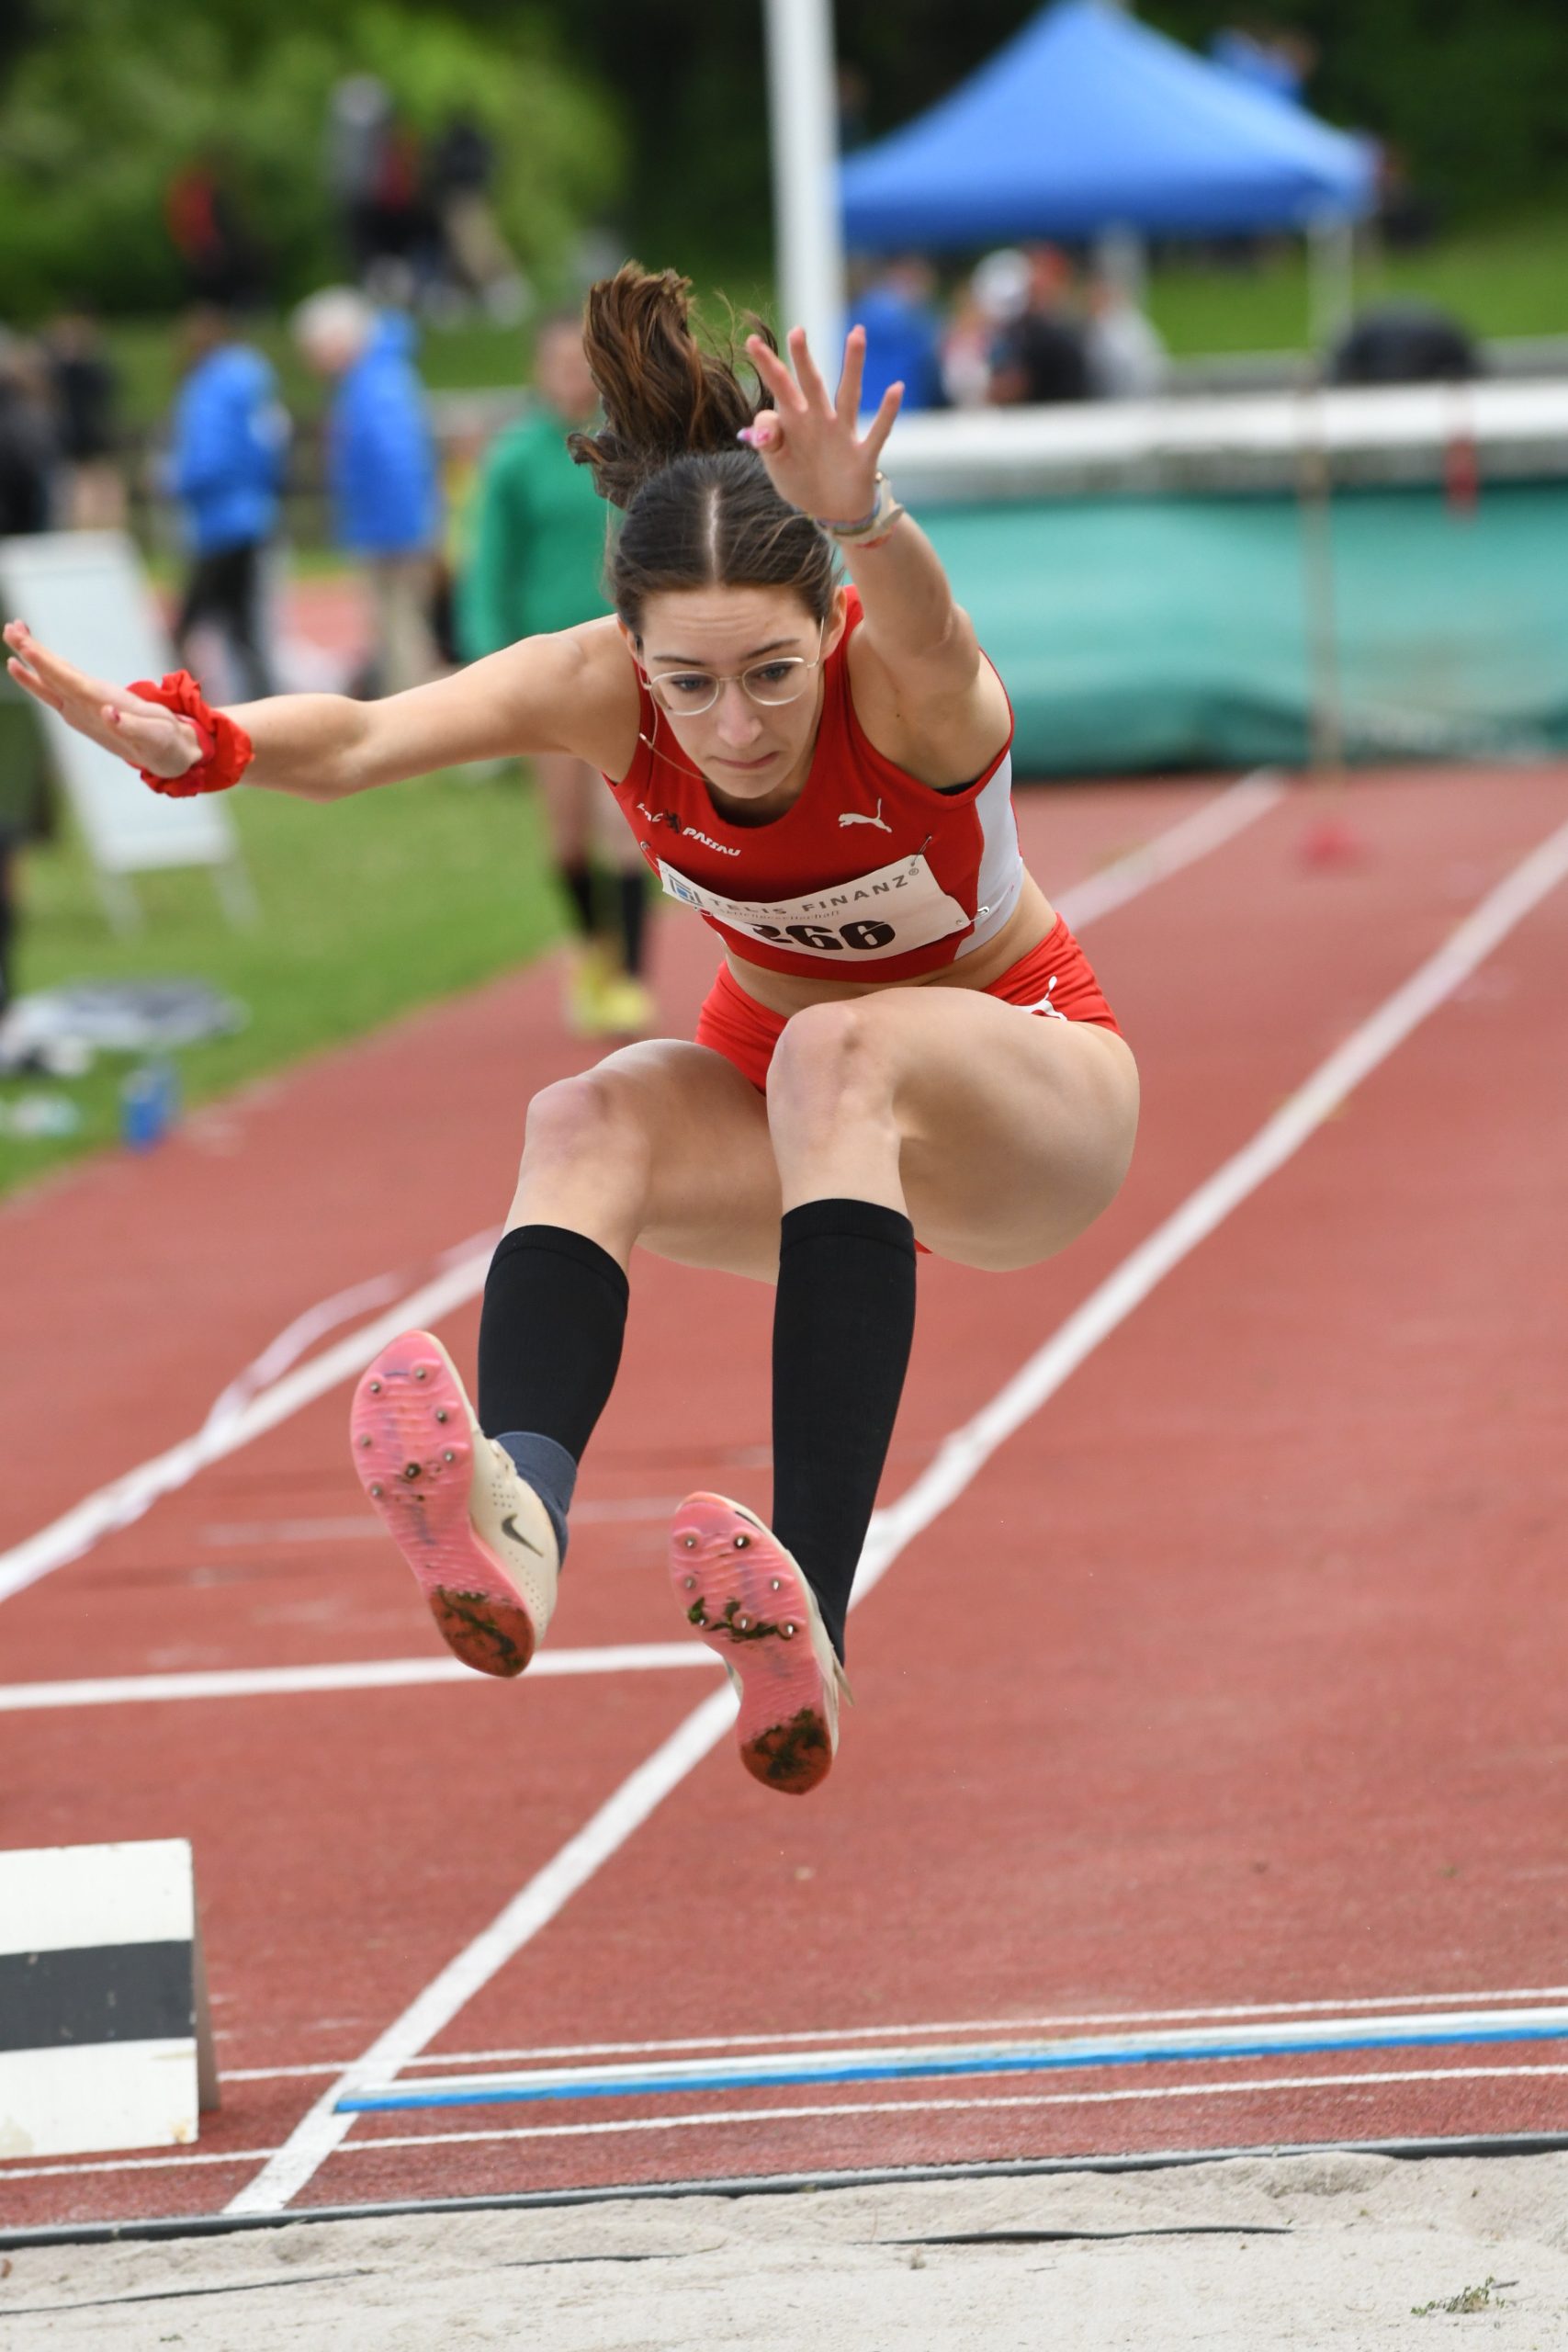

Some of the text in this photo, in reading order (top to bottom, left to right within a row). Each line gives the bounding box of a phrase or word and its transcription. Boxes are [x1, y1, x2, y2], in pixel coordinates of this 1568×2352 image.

[682, 827, 741, 856] PASSAU
[708, 898, 787, 914] TELIS
[744, 920, 897, 951] 266
